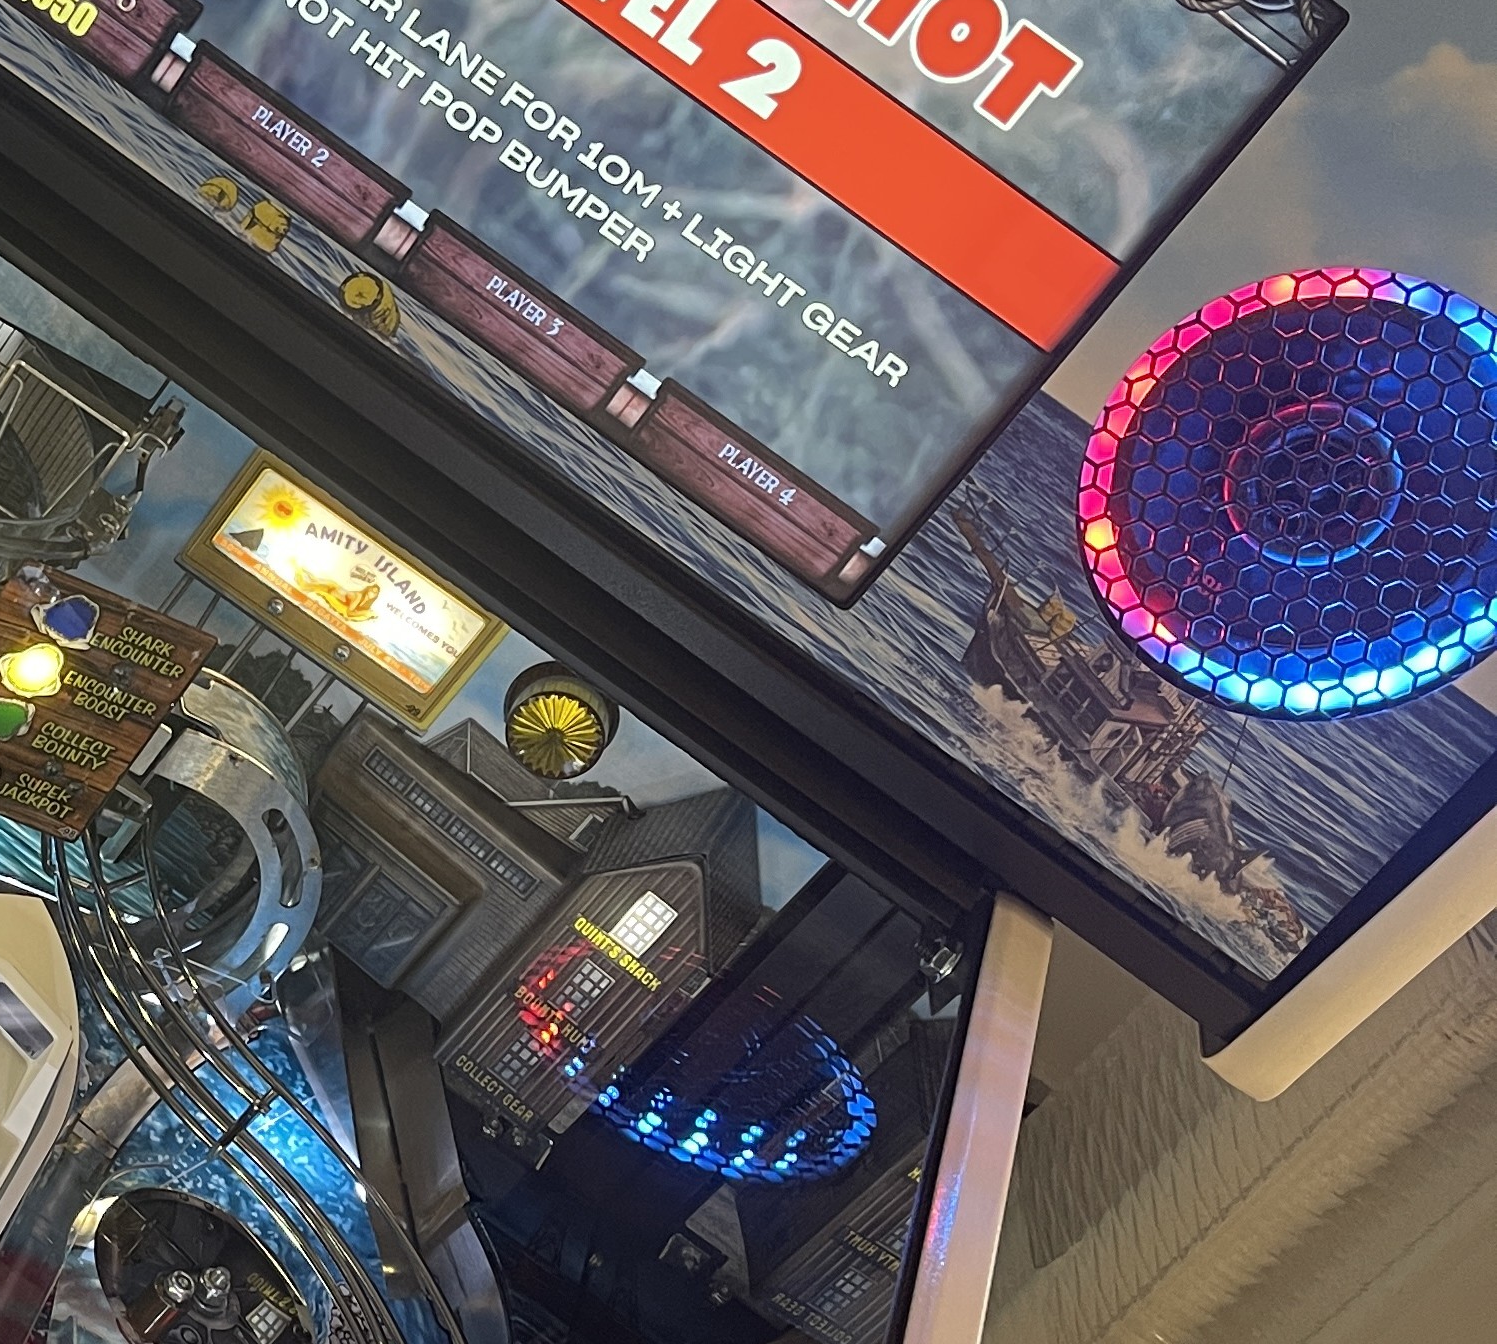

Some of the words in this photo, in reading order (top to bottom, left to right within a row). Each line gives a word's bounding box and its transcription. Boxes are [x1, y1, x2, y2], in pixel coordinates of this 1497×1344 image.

[718, 37, 803, 121] 2
[251, 102, 315, 159] PLAYER
[311, 145, 331, 169] 2
[351, 28, 428, 97] HIT
[419, 79, 504, 153] POP
[498, 136, 658, 264] BUMPER
[398, 7, 509, 102] LANE
[500, 79, 579, 152] FOR
[574, 136, 664, 213] 10M
[659, 197, 683, 223] +
[678, 212, 807, 312] LIGHT
[801, 297, 912, 391] GEAR
[485, 275, 549, 330] PLAYER
[544, 313, 564, 338] 3
[718, 440, 782, 499] PLAYER
[776, 485, 796, 509] 4
[305, 522, 369, 555] AMITY
[374, 555, 426, 615] ISLAND
[91, 633, 184, 680] ENCOUNTER
[120, 626, 175, 656] SHARK
[387, 602, 440, 644] WELCOMES
[440, 641, 461, 658] YOU
[63, 669, 157, 720] ENCOUNTER
[72, 693, 130, 724] BOOST
[31, 732, 107, 772] BOUNTY
[39, 721, 116, 759] COLLECT
[15, 773, 73, 806] SUPER
[574, 917, 620, 962] QUINT'S
[616, 954, 661, 992] SHACK
[455, 1054, 506, 1103] COLLECT
[503, 1092, 533, 1124] GEAR
